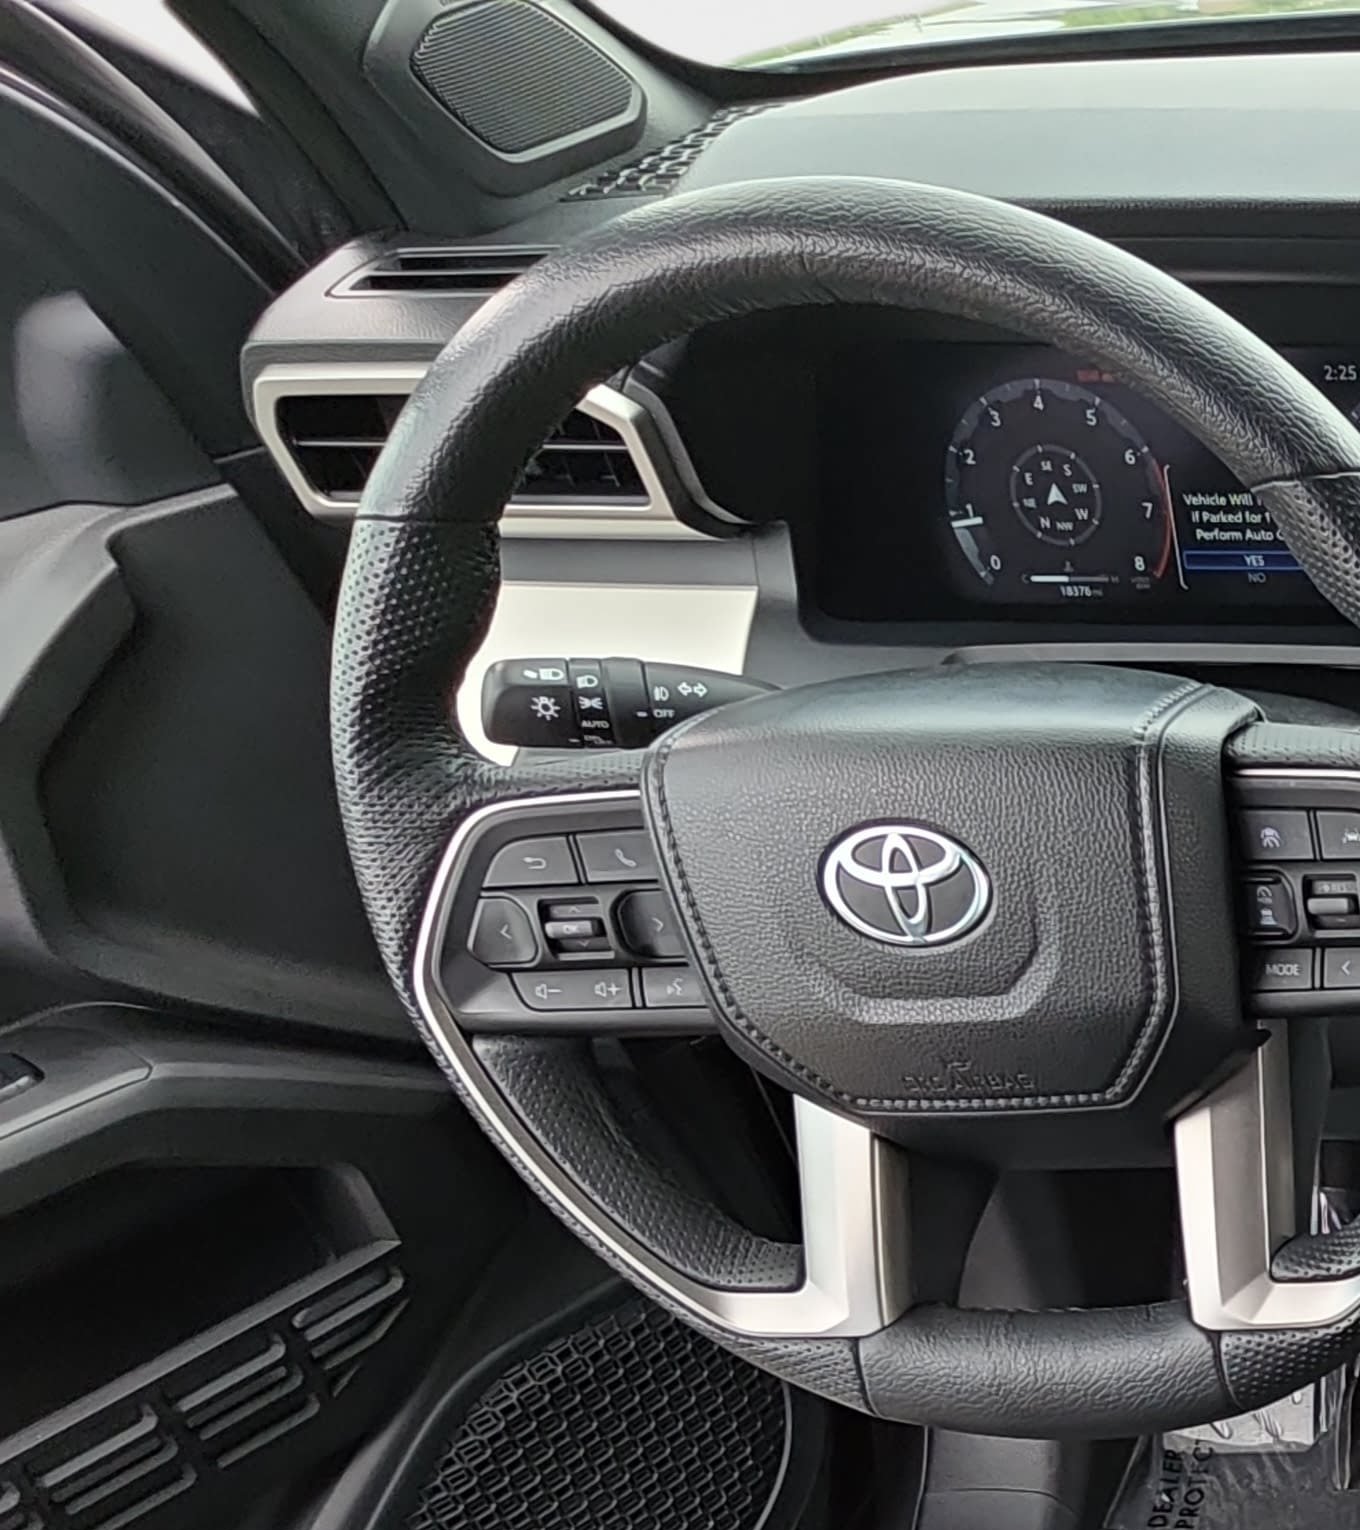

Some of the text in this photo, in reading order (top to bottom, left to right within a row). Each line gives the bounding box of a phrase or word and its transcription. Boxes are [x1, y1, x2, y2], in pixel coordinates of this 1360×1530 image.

[1324, 365, 1357, 381] 2:25
[1033, 394, 1043, 410] 4
[990, 411, 1001, 427] 3
[1086, 410, 1097, 425] 5
[963, 450, 977, 465] 2
[1124, 450, 1136, 465] 6
[1063, 464, 1072, 476] S
[1025, 473, 1033, 485] E
[1183, 493, 1227, 506] Vehicle
[1228, 493, 1253, 506] Will
[1142, 503, 1152, 518] 7
[1192, 511, 1200, 523] If
[1202, 511, 1242, 523] Parked
[1245, 511, 1261, 523] for
[1196, 528, 1243, 541] Perform
[1245, 528, 1274, 541] Auto
[990, 555, 1001, 570] 0
[1134, 555, 1145, 571] 8
[1244, 555, 1264, 567] YES
[1248, 573, 1267, 583] NO
[581, 720, 610, 729] AUTO
[1265, 963, 1301, 977] MODE
[1147, 1449, 1185, 1528] DEALER
[1174, 1441, 1214, 1529] PROTEC
